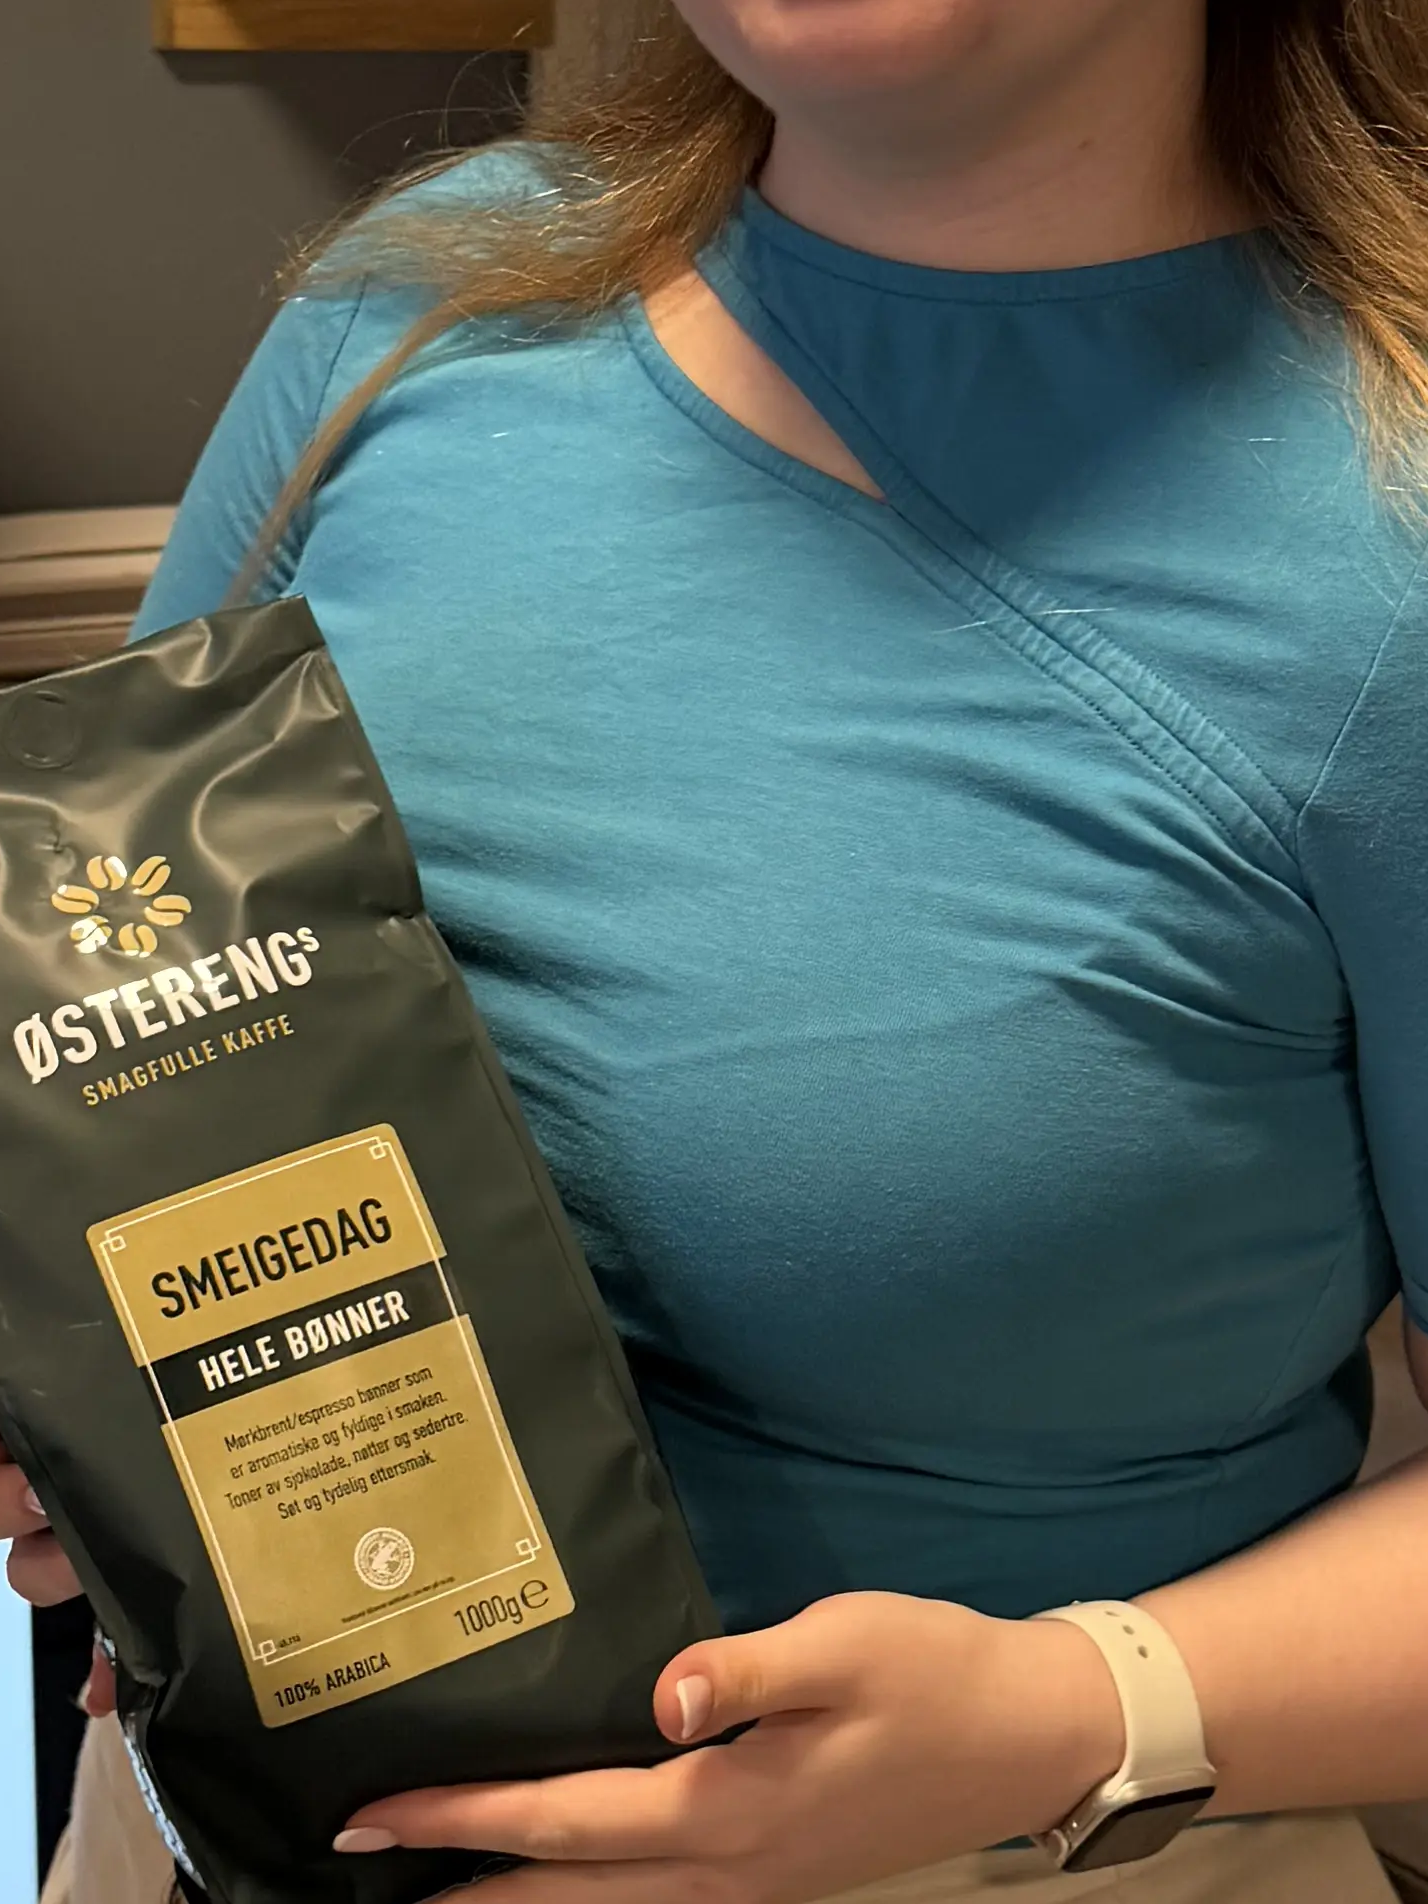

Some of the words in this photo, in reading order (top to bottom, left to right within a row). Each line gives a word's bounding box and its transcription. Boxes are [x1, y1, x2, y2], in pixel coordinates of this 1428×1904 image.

[81, 1038, 219, 1107] SMAGFULLE
[221, 1013, 296, 1056] KAFFE
[151, 1197, 393, 1319] SMEIGEDAG
[197, 1334, 282, 1393] HELE
[283, 1290, 411, 1362] BØNNER
[405, 1366, 434, 1387] som
[223, 1486, 263, 1510] Toner
[266, 1480, 282, 1496] av
[394, 1430, 411, 1449] og
[229, 1464, 245, 1480] er
[247, 1434, 320, 1474] aromatiske
[322, 1429, 340, 1448] og
[340, 1413, 386, 1442] fyldige
[277, 1500, 302, 1520] Søt
[304, 1493, 322, 1512] og
[322, 1476, 369, 1506] tydelig
[273, 1678, 322, 1708] 100%
[324, 1651, 392, 1692] ARABICA
